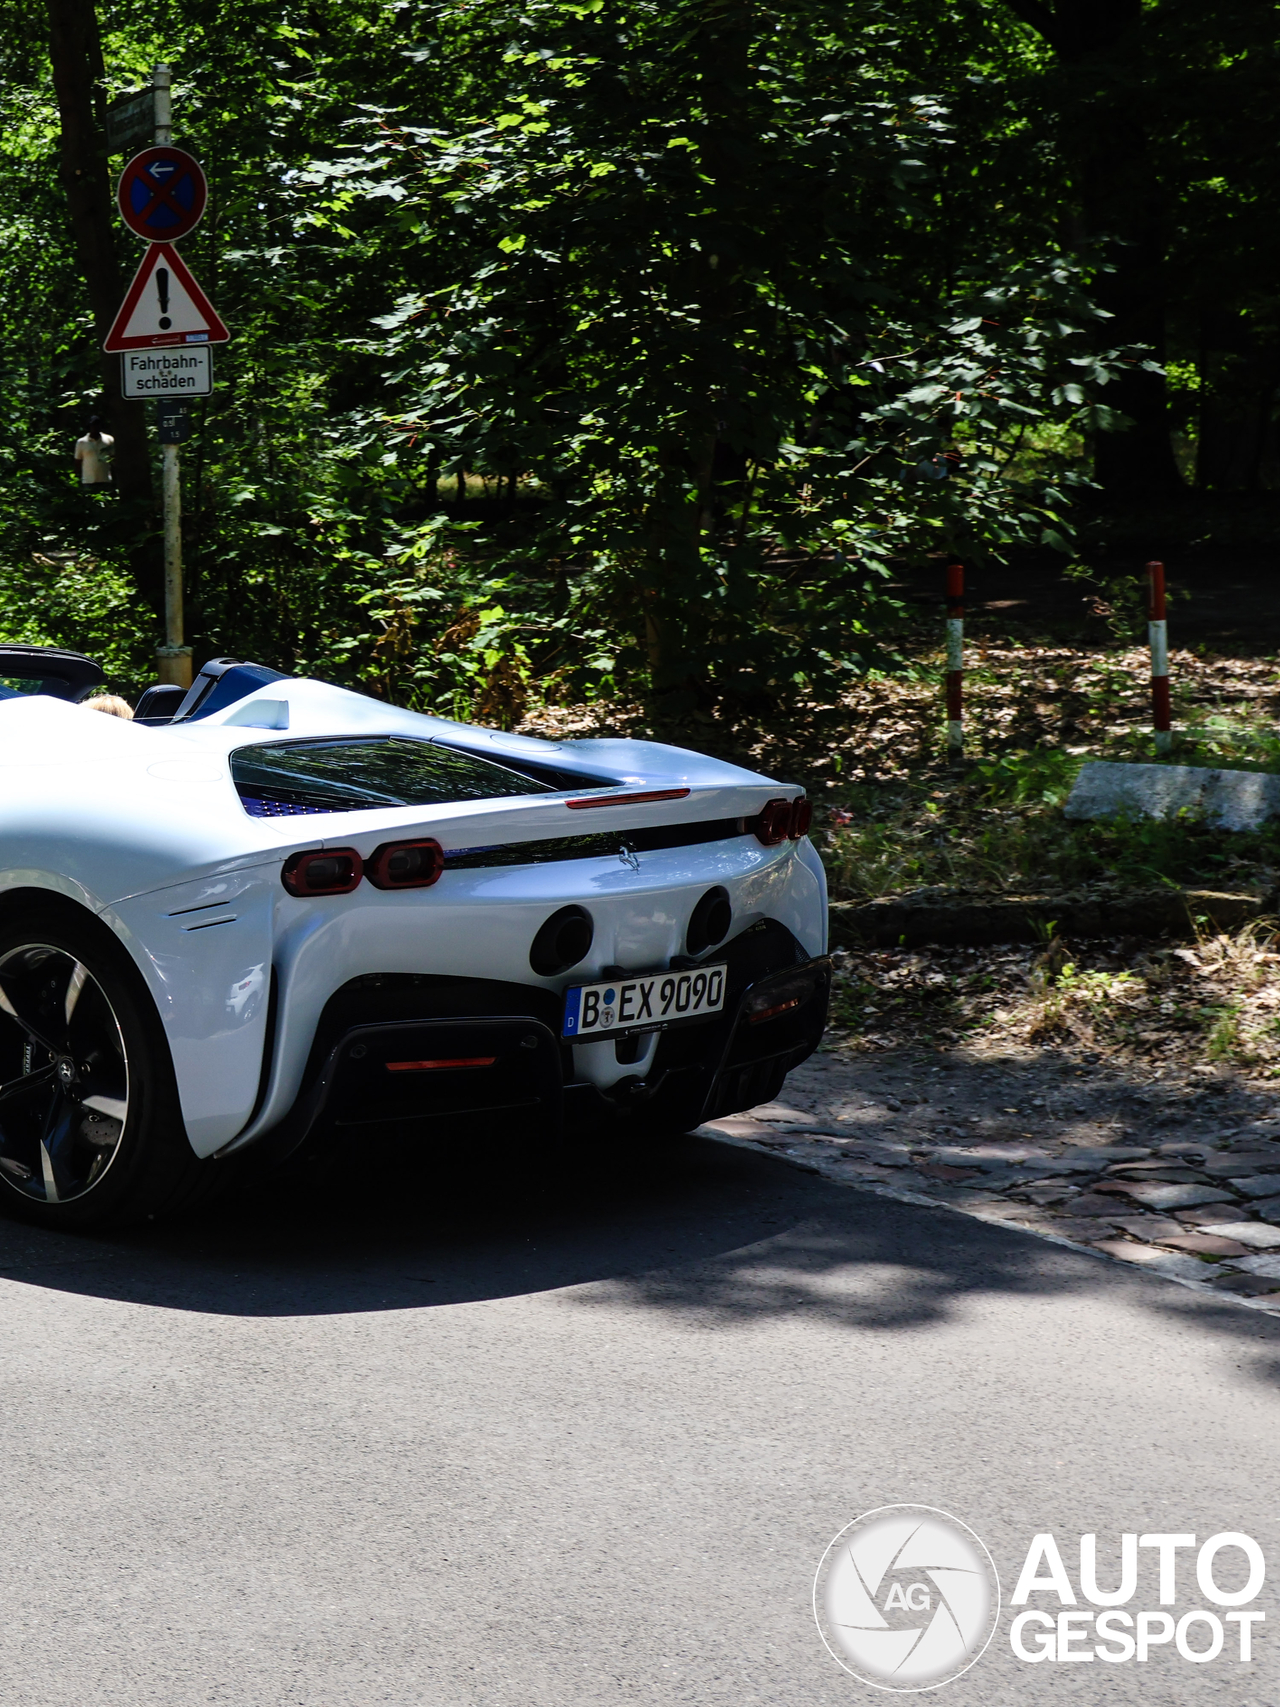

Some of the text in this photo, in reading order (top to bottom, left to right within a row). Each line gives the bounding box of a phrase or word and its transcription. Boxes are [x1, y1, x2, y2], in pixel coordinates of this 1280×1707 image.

[131, 355, 203, 370] Fahrbahn-
[136, 374, 195, 390] schäden
[582, 970, 723, 1028] B EX 9090
[567, 1017, 575, 1028] D
